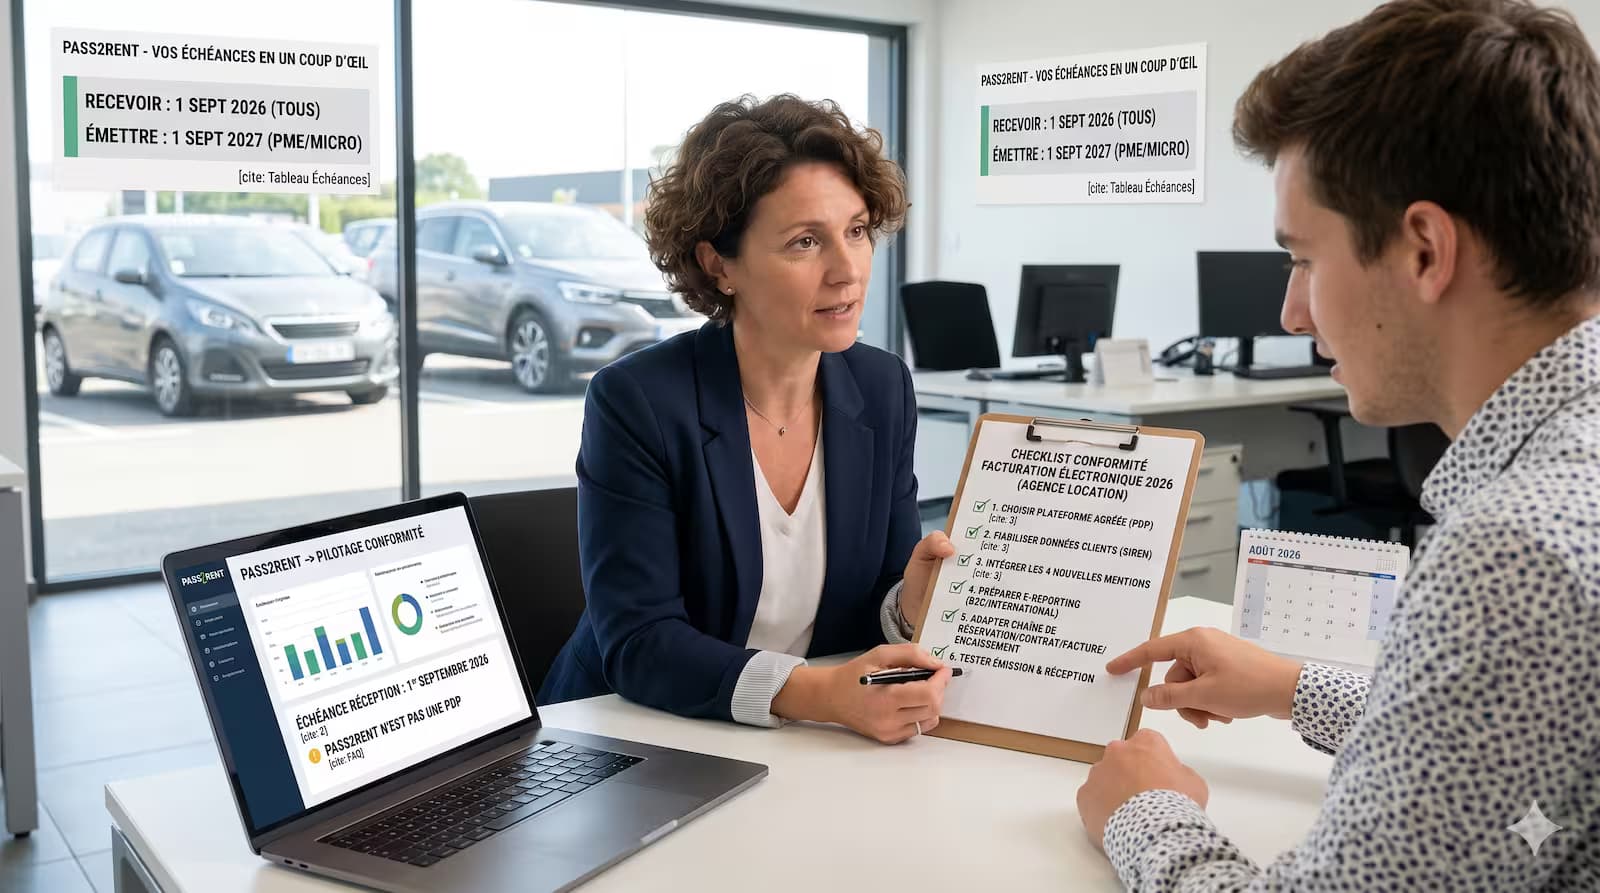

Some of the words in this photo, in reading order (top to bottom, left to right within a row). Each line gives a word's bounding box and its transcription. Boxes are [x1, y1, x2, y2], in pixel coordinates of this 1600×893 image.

[63, 40, 140, 58] PASS2RENT
[151, 44, 178, 60] VOS
[181, 43, 256, 64] ÉCHÉANCES
[259, 50, 275, 65] EN
[278, 51, 296, 65] UN
[299, 53, 333, 67] COUP
[981, 71, 1029, 87] PASS2RENT
[1035, 68, 1053, 82] VOS
[1055, 63, 1108, 81] ÉCHÉANCES
[1110, 62, 1123, 76] EN
[1124, 61, 1138, 75] UN
[1140, 58, 1168, 73] COUP
[85, 92, 162, 112] RECEVOIR
[175, 97, 182, 113] 1
[189, 97, 227, 114] SEPT
[230, 99, 267, 116] 2026
[271, 99, 321, 121] (TOUS)
[993, 116, 1041, 133] RECEVOIR
[1050, 115, 1055, 130] 1
[1058, 113, 1086, 129] SEPT
[1088, 111, 1115, 128] 2026
[1117, 107, 1156, 130] (TOUS)
[85, 122, 159, 145] ÉMETTRE
[172, 130, 179, 145] 1
[185, 130, 224, 147] SEPT
[227, 131, 263, 148] 2027
[267, 131, 362, 154] (PME/MICRO)
[992, 144, 1039, 162] ÉMETTRE
[1047, 146, 1052, 161] 1
[1055, 144, 1083, 160] SEPT
[1085, 143, 1112, 159] 2027
[1114, 139, 1190, 162] (PME/MICRO)
[238, 169, 265, 185] [cite:
[267, 171, 309, 184] Tableau
[312, 169, 371, 188] Échéances]
[1087, 180, 1109, 197] [cite:
[1109, 180, 1143, 194] Tableau
[1145, 178, 1195, 195] Échéances]
[1011, 448, 1073, 465] CHECKLIST
[1073, 454, 1149, 472] CONFORMITÉ
[981, 459, 1057, 478] FACTURATION
[1058, 466, 1144, 487] ÉLECTRONIQUE
[1144, 476, 1173, 490] 2026
[1017, 479, 1067, 494] (AGENCE
[1067, 483, 1128, 503] LOCATION)
[988, 513, 1007, 524] [cite:
[1008, 515, 1018, 527] 3]
[992, 503, 999, 512] 1.
[1001, 503, 1036, 516] CHOISIR
[1036, 507, 1094, 523] PLATEFORME
[1093, 514, 1128, 527] AGRÉÉE
[1128, 518, 1154, 532] (PDP)
[239, 554, 302, 581] PASS2RENT
[315, 540, 365, 563] PILOTAGE
[364, 524, 425, 551] CONFORMITÉ
[980, 540, 1001, 551] [cite:
[1001, 543, 1010, 554] 3]
[983, 529, 991, 539] 2.
[993, 531, 1039, 545] FIABILISER
[1039, 536, 1080, 550] DONNÉES
[1081, 542, 1118, 555] CLIENTS
[1119, 546, 1153, 561] (SIREN)
[1248, 544, 1276, 557] AOÛT
[1277, 548, 1301, 560] 2026
[972, 567, 993, 579] [cite:
[993, 570, 1003, 582] 3]
[975, 557, 983, 567] 3.
[985, 558, 1027, 573] INTÉGRER
[1027, 564, 1044, 575] LES
[1045, 567, 1051, 576] 4
[1052, 567, 1103, 583] NOUVELLES
[1103, 574, 1151, 589] MENTIONS
[965, 595, 1059, 620] (B2C/INTERNATIONAL)
[968, 585, 976, 594] 4.
[977, 586, 1022, 601] PRÉPARER
[1022, 592, 1081, 609] E-REPORTING
[960, 612, 968, 622] 5.
[969, 614, 1010, 628] ADAPTER
[1010, 620, 1045, 633] CHAÎNE
[1044, 624, 1057, 636] DE
[954, 635, 1021, 654] ENCAISSEMENT
[949, 651, 957, 662] 6.
[959, 653, 992, 667] TESTER
[992, 658, 1035, 674] ÉMISSION
[1035, 665, 1043, 675] &
[1044, 666, 1095, 684] RÉCEPTION
[295, 701, 350, 731] ÉCHÉANCE
[348, 683, 401, 712] RÉCEPTION
[417, 660, 469, 687] SEPTEMBRE
[468, 653, 489, 670] 2026
[300, 729, 320, 745] [cite:
[318, 724, 329, 737] 2]
[324, 725, 379, 757] PASS2RENT
[406, 708, 425, 726] PAS
[425, 701, 445, 718] UNE
[443, 695, 462, 712] PDP
[328, 756, 347, 771] [cite:
[346, 747, 365, 763] FAQ]
